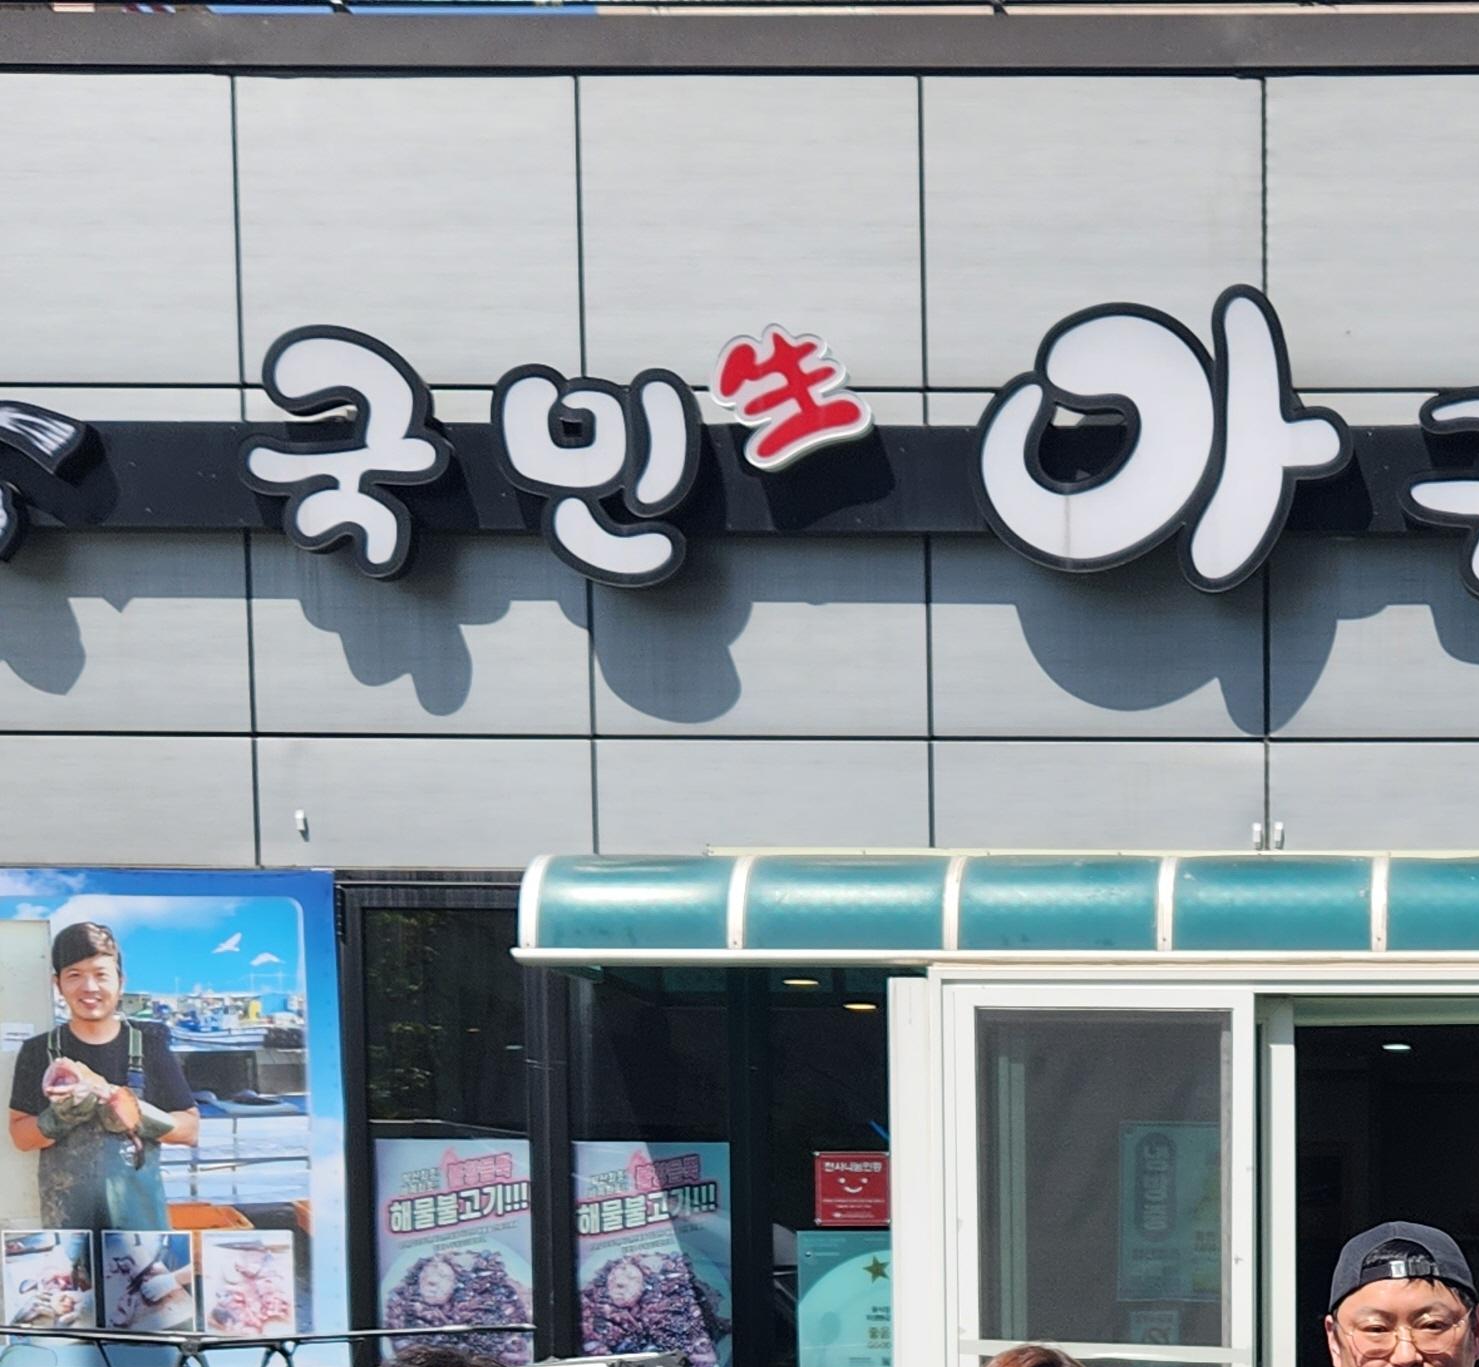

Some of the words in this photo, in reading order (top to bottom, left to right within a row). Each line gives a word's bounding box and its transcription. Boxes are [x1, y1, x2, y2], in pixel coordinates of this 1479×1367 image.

[239, 325, 701, 587] 국민
[712, 324, 873, 473] 生
[389, 1181, 529, 1233] 해물불고기!!!
